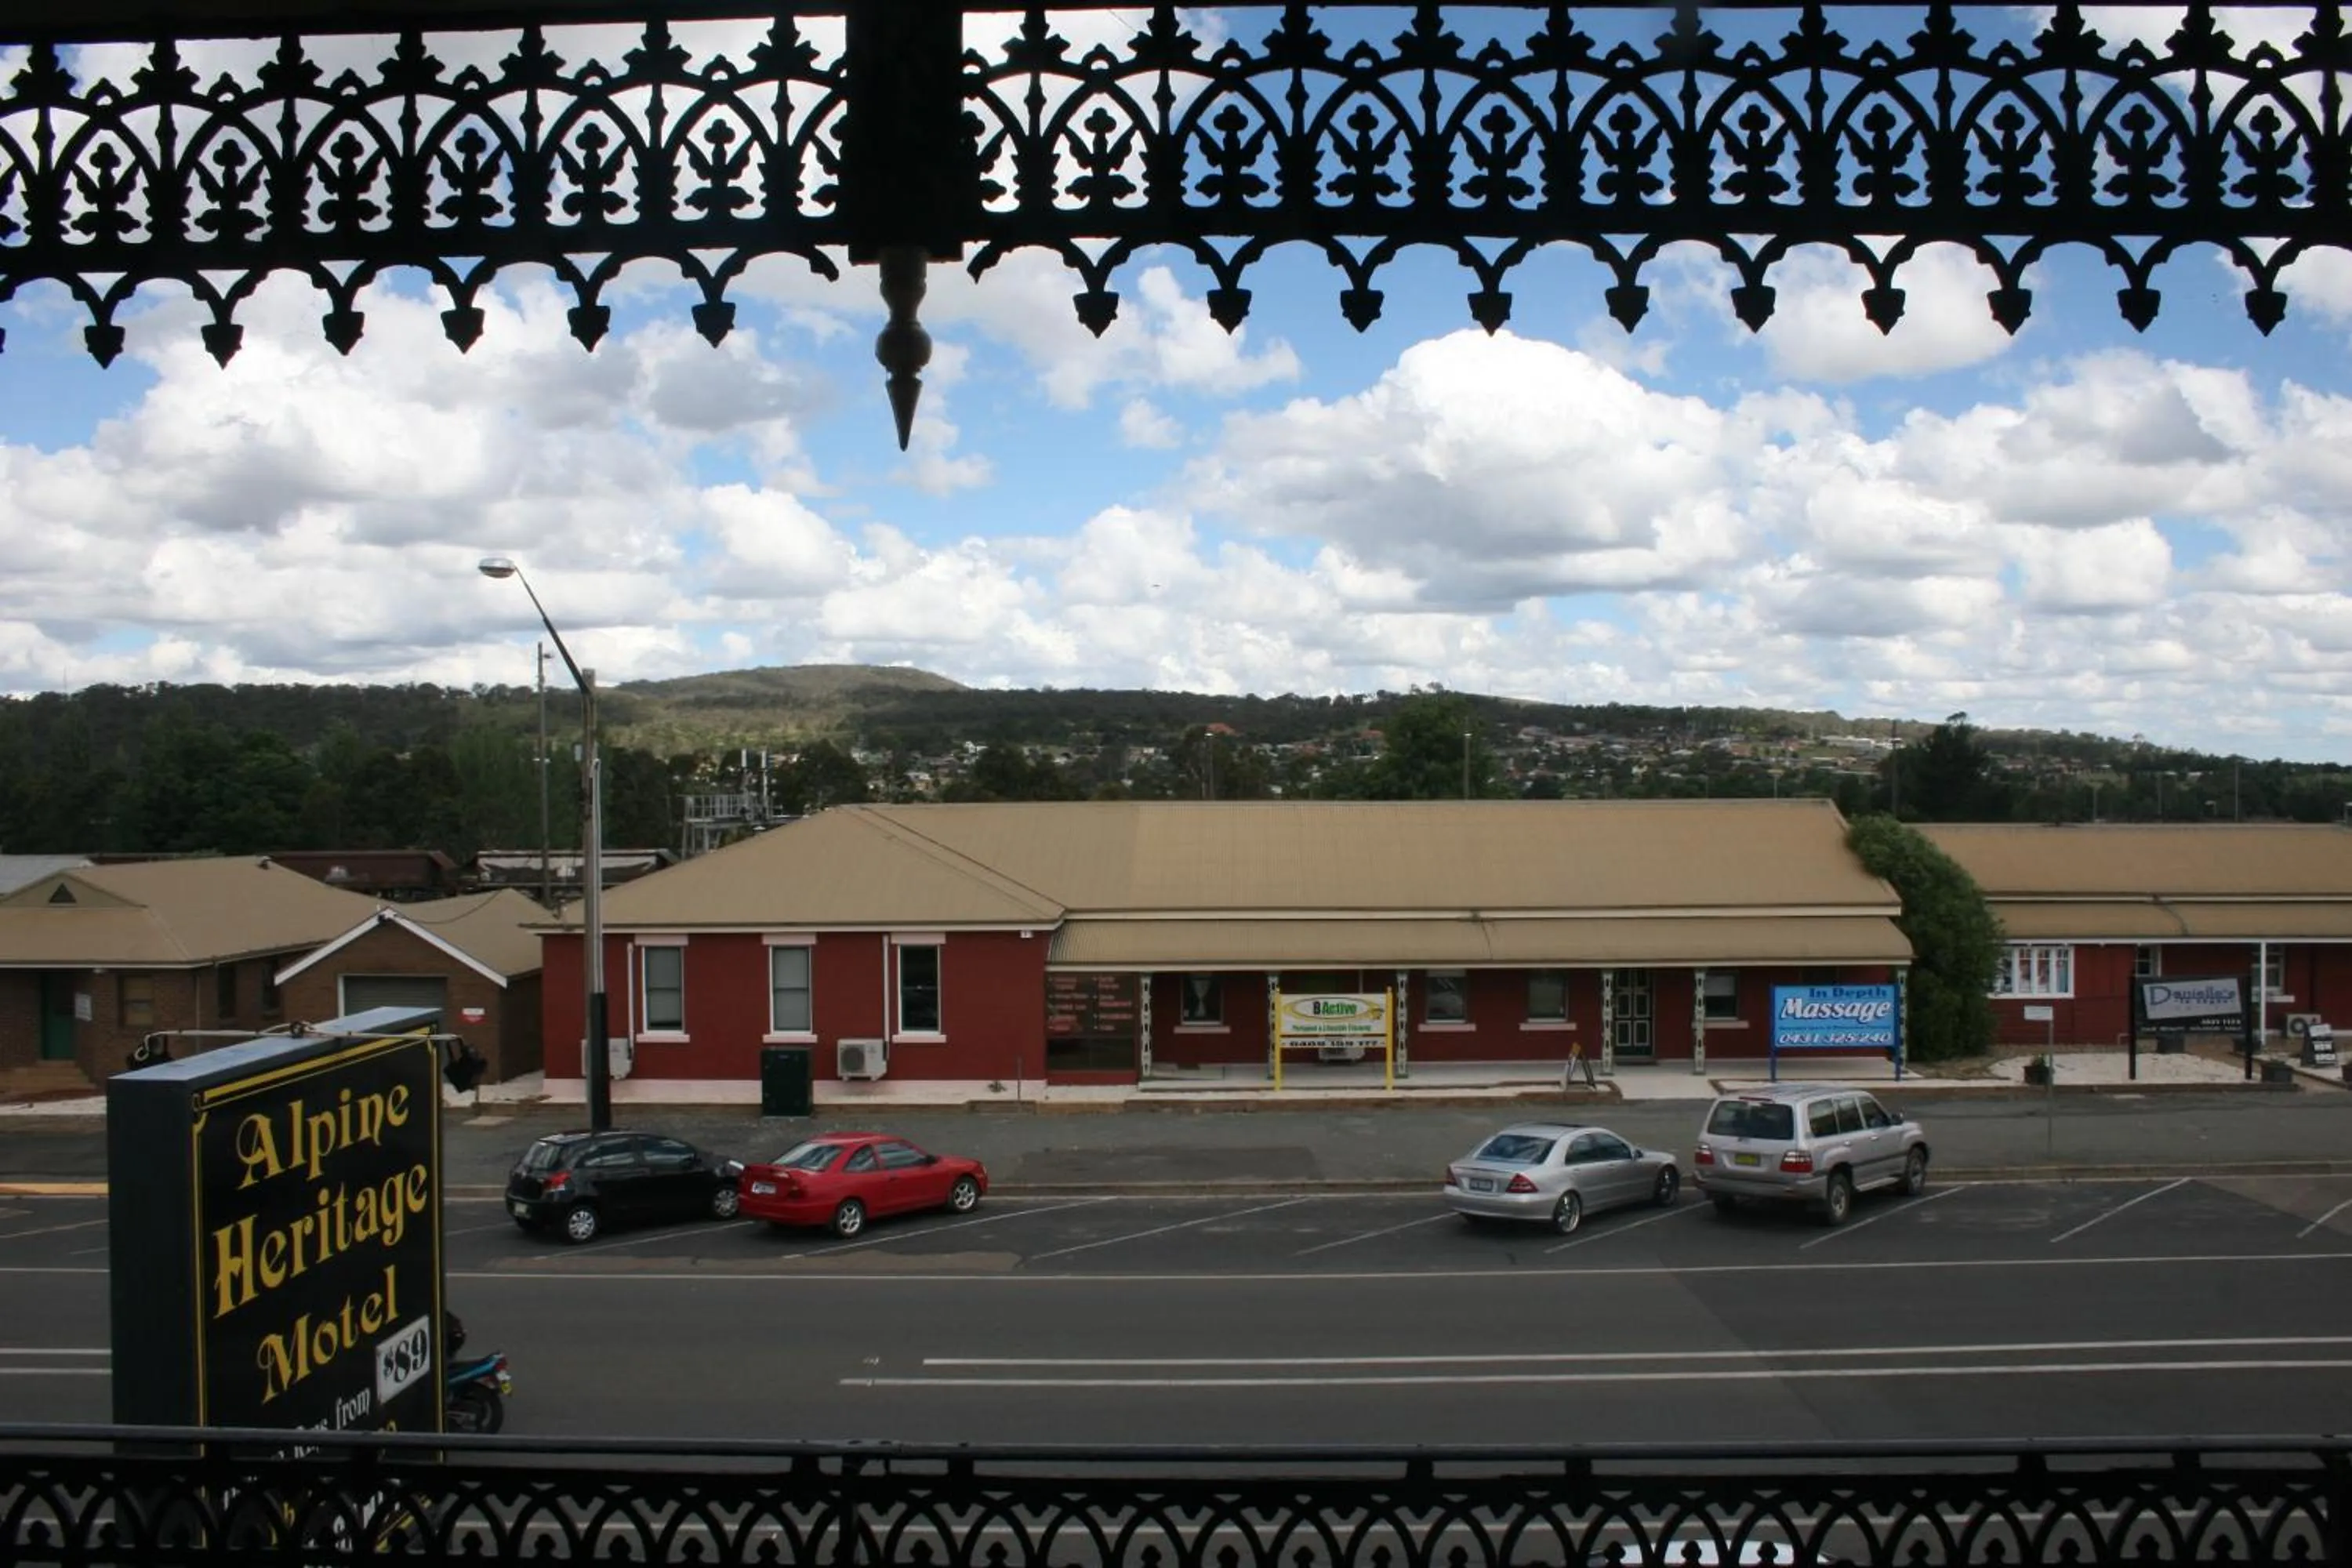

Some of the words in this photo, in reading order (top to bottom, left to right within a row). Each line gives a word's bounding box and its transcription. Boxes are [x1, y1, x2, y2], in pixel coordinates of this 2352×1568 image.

[1322, 1001, 1357, 1015] Active
[1780, 997, 1893, 1023] Massage
[1809, 988, 1828, 998] In
[1832, 987, 1887, 999] Depth
[237, 1084, 409, 1190] Alpine
[212, 1163, 428, 1319] Heritage
[256, 1264, 401, 1404] Motel
[336, 1387, 371, 1431] from
[383, 1328, 428, 1384] $89
